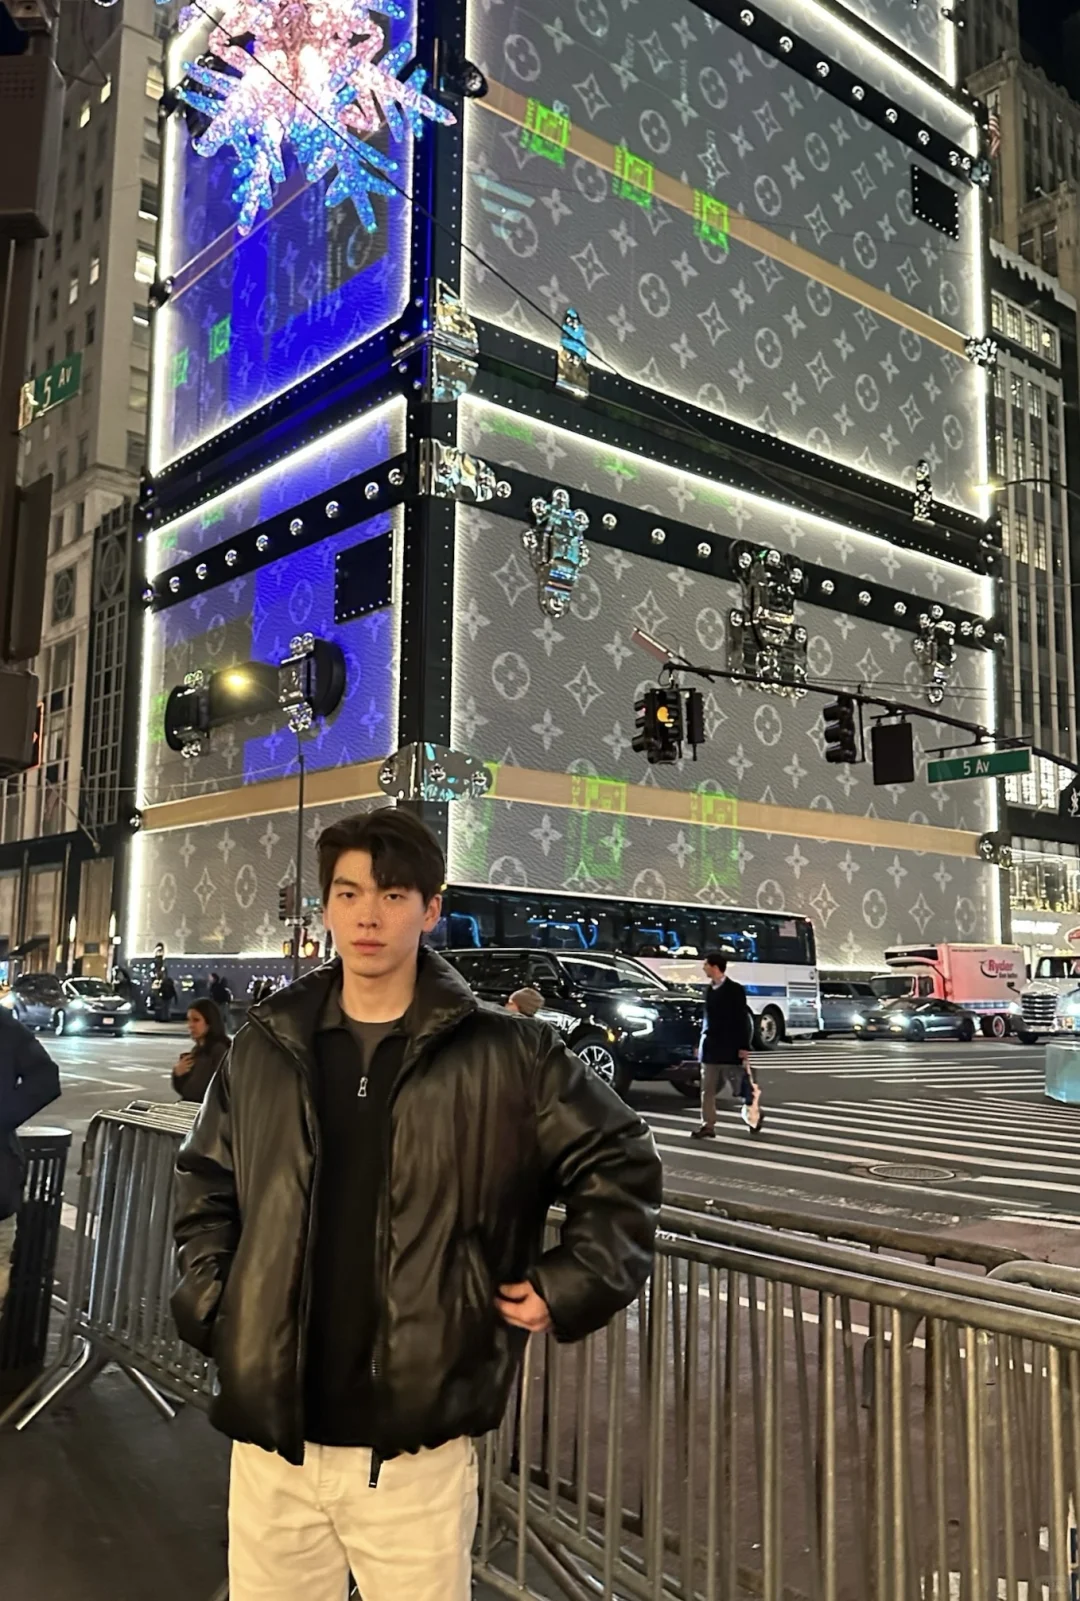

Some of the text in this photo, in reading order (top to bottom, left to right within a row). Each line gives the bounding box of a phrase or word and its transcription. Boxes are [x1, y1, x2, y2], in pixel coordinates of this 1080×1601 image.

[42, 375, 53, 408] 5
[963, 759, 990, 776] 5 Av
[988, 959, 1014, 973] Ryder
